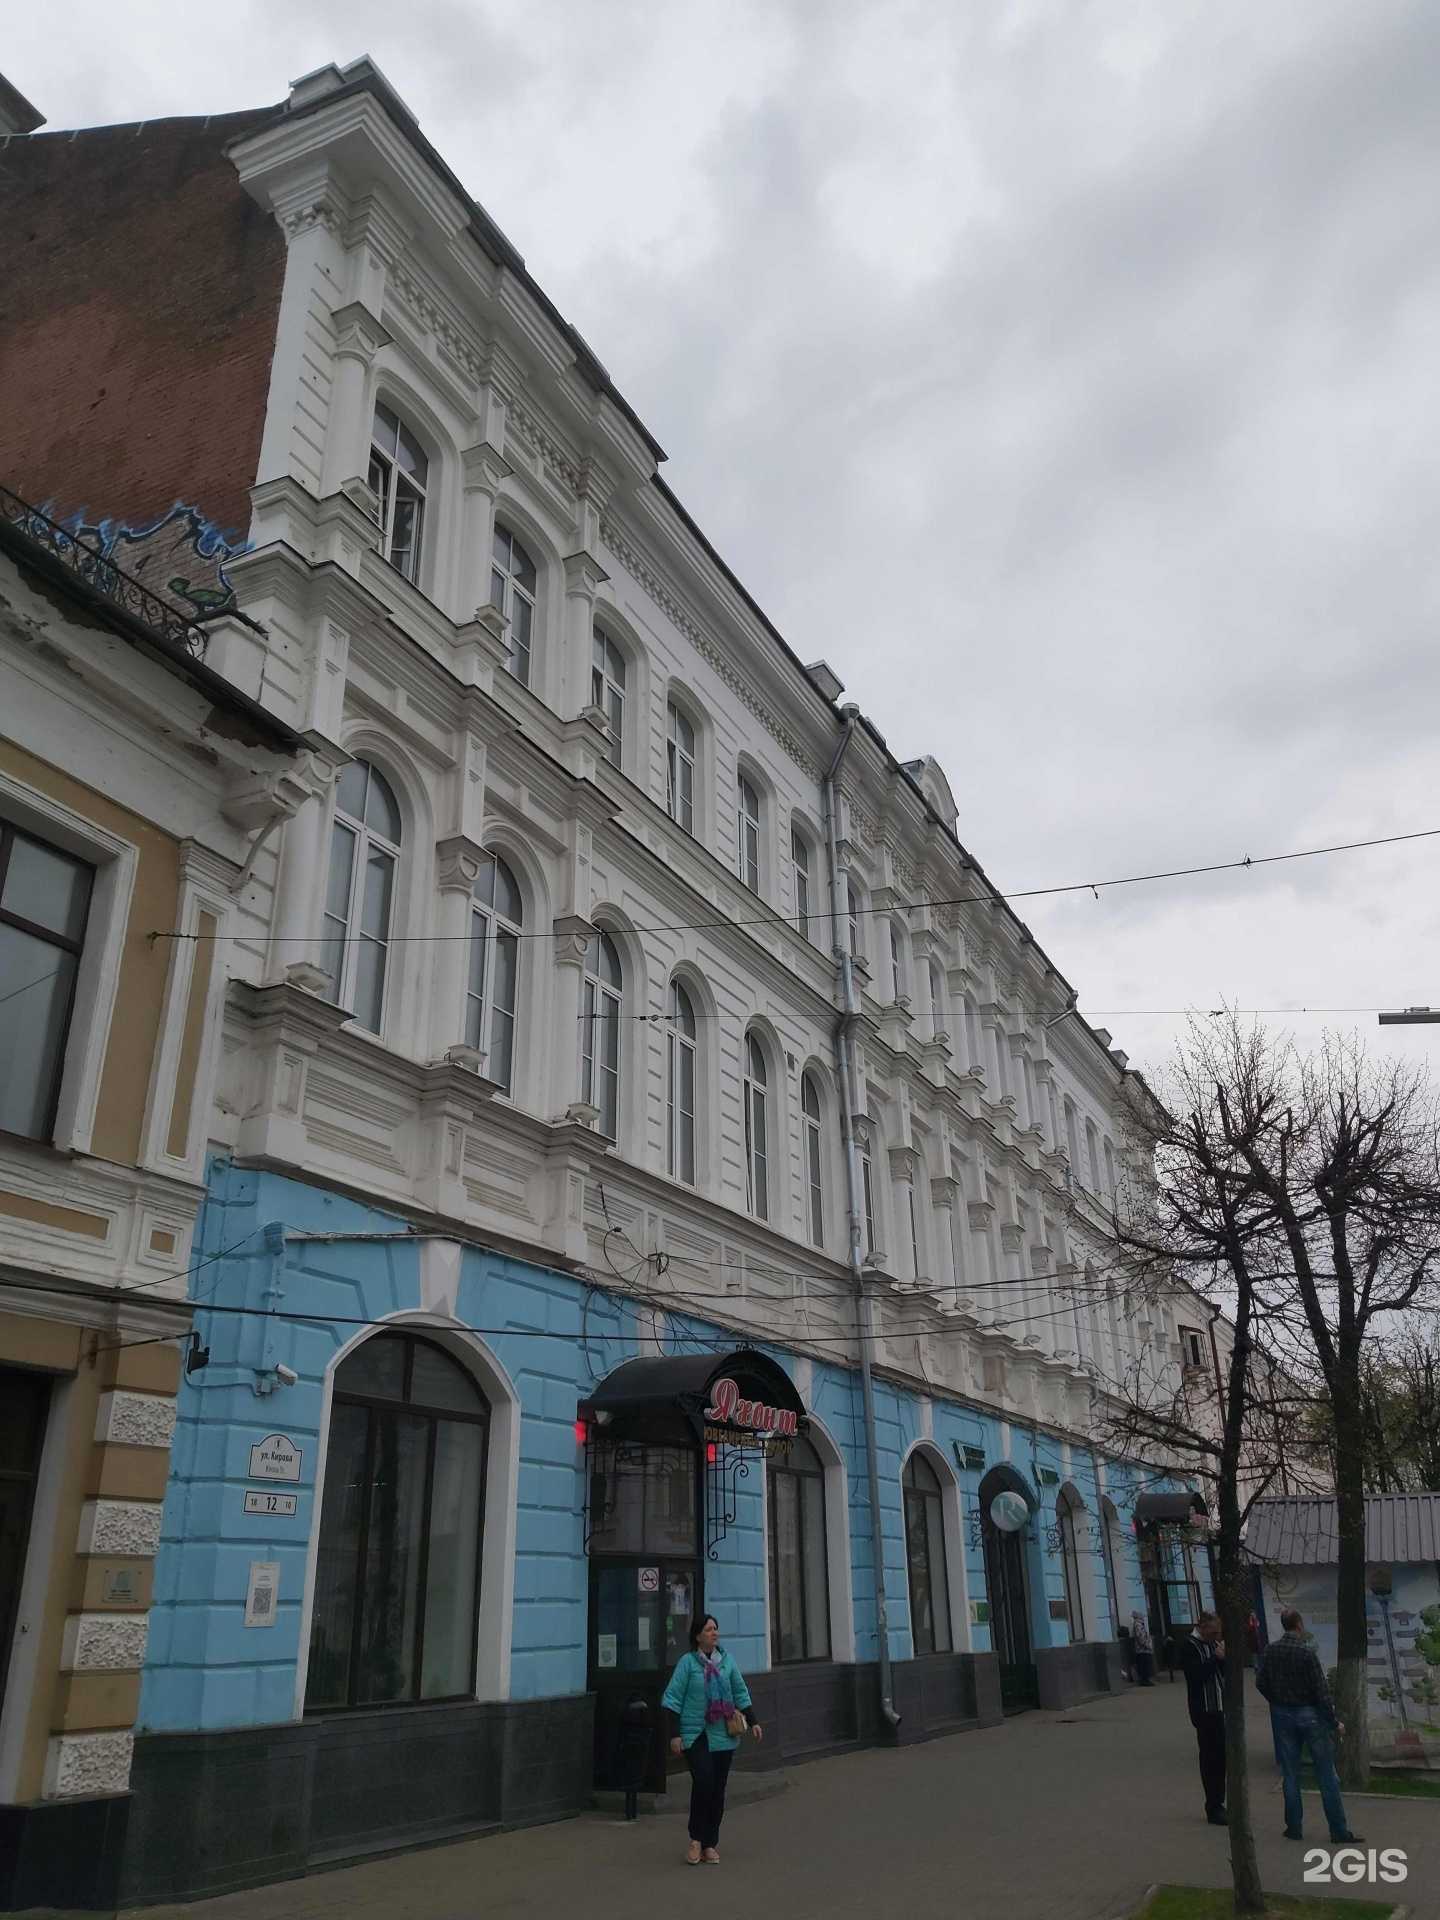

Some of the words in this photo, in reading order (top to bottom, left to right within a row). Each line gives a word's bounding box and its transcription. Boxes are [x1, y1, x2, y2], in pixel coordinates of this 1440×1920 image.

[705, 1378, 798, 1437] Яхонт
[260, 1452, 269, 1462] ул.
[271, 1451, 293, 1463] Кирова
[267, 1496, 277, 1511] 12
